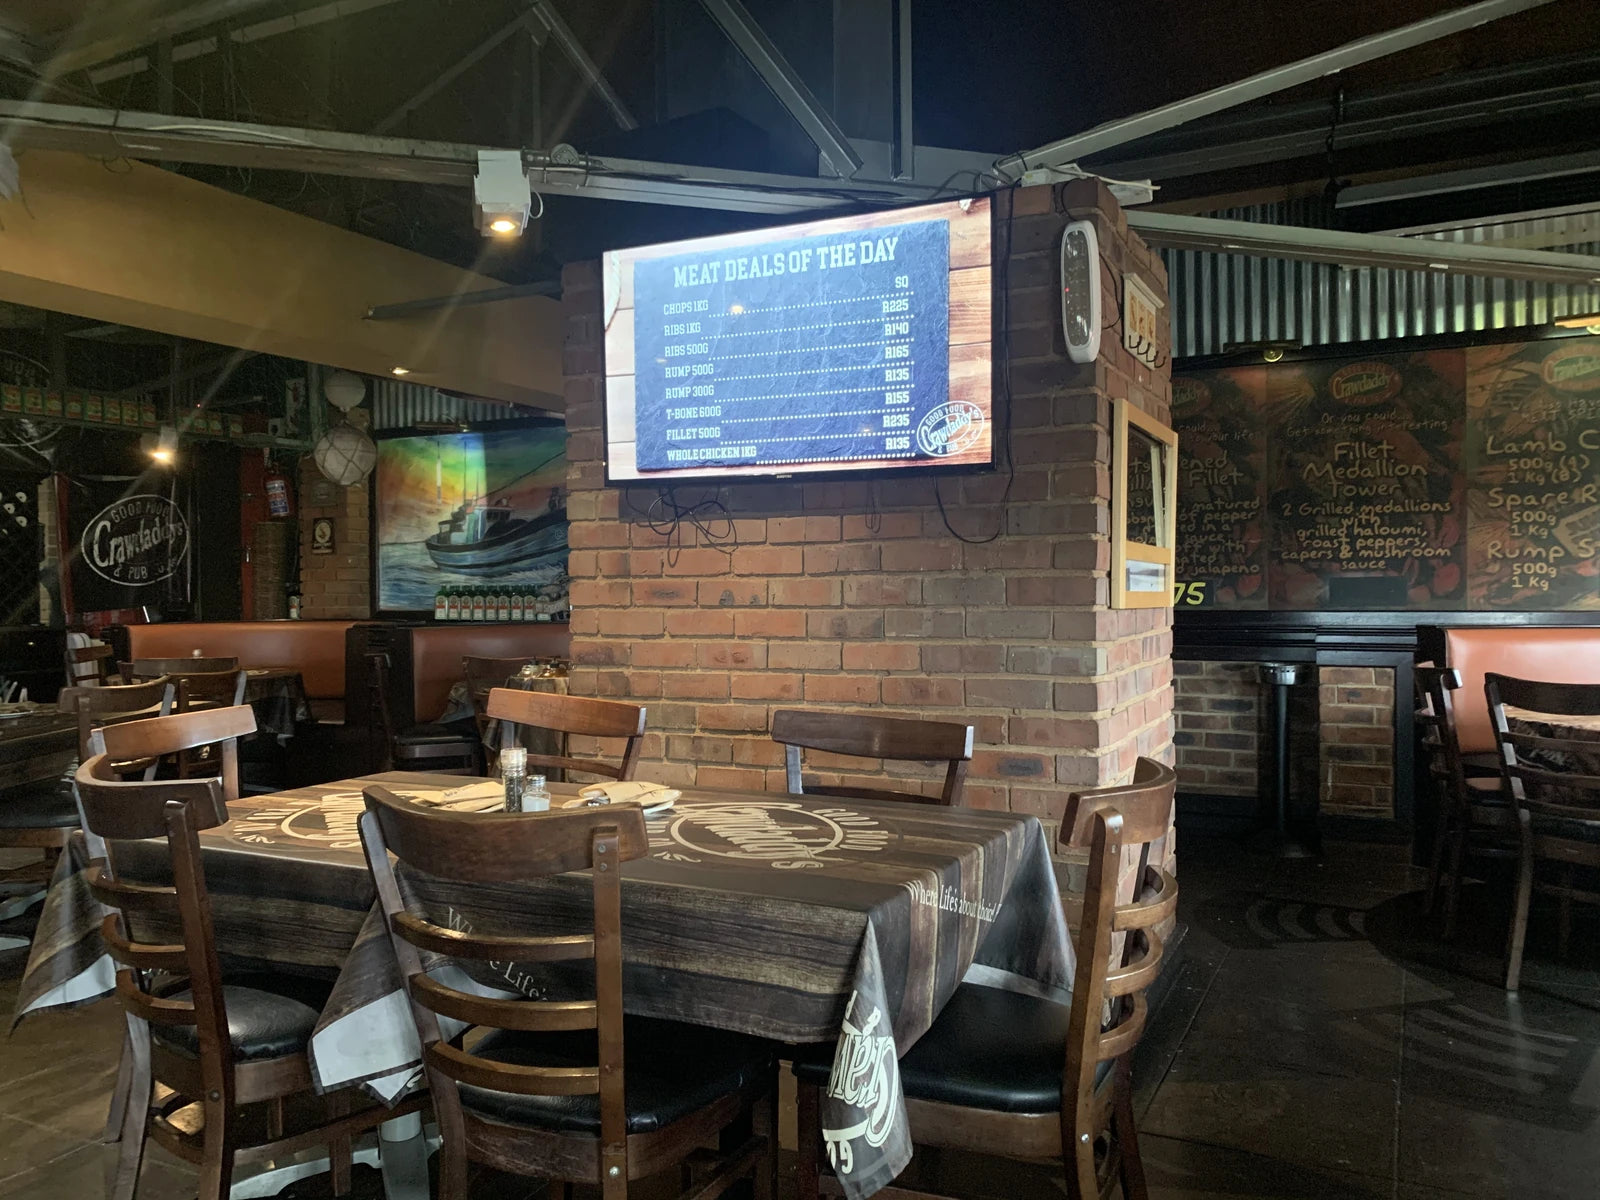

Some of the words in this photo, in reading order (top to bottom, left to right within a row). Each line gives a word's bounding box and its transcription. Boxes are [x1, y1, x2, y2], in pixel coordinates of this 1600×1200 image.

[673, 261, 720, 288] MEAT
[724, 252, 785, 282] DEALS
[788, 248, 812, 273] OF
[816, 243, 856, 270] THE
[860, 236, 899, 265] DAY
[663, 301, 693, 315] CHOPS
[693, 299, 709, 312] 1KG
[895, 275, 909, 288] SQ
[664, 324, 685, 336] RIBS
[686, 321, 701, 334] 1KG
[882, 299, 909, 313] R225
[664, 345, 686, 357] RIBS
[687, 343, 709, 355] 500G
[885, 321, 909, 336] R140
[665, 366, 691, 378] RUMP
[692, 363, 714, 376] 500G
[884, 345, 909, 359] R165
[665, 387, 691, 399] RUMP
[692, 385, 715, 397] 300G
[885, 368, 909, 382] R135
[666, 407, 698, 420] T-BONE
[699, 405, 721, 418] 600G
[885, 391, 910, 405] R155
[666, 428, 697, 440] FILLET
[699, 427, 721, 439] 500G
[883, 414, 910, 428] R235
[1342, 414, 1361, 425] you
[666, 449, 699, 461] WHOLE
[699, 446, 741, 460] CHICKEN
[741, 445, 757, 458] 1KG
[885, 437, 910, 450] R135
[1334, 439, 1397, 462] Fillet
[1486, 431, 1567, 456] Lamb
[1179, 450, 1227, 470] ened
[1302, 457, 1428, 481] Medallion
[1509, 457, 1554, 473] 500g
[1189, 467, 1245, 487] Fillet
[1328, 481, 1402, 498] Tower
[1487, 486, 1569, 512] Spare
[110, 500, 142, 524] GOOD
[1192, 498, 1260, 513] matured
[1282, 503, 1292, 517] 2
[1298, 501, 1354, 516] Grilled
[1359, 499, 1452, 514] medallions
[1203, 511, 1257, 524] pepper
[1341, 510, 1382, 526] with
[1511, 510, 1557, 526] 500g
[1296, 523, 1348, 541] grilled
[1353, 520, 1428, 537] haloumi,
[1208, 540, 1246, 553] with
[1302, 535, 1351, 549] roast
[1355, 537, 1428, 549] peppers,
[1487, 540, 1566, 563] Rump
[1281, 549, 1333, 562] capers
[1338, 546, 1353, 560] &
[1358, 546, 1452, 559] mushroom
[127, 565, 149, 580] PUB
[1191, 561, 1261, 576] jalapeno
[1341, 560, 1387, 570] sauce
[1512, 562, 1558, 578] 500g
